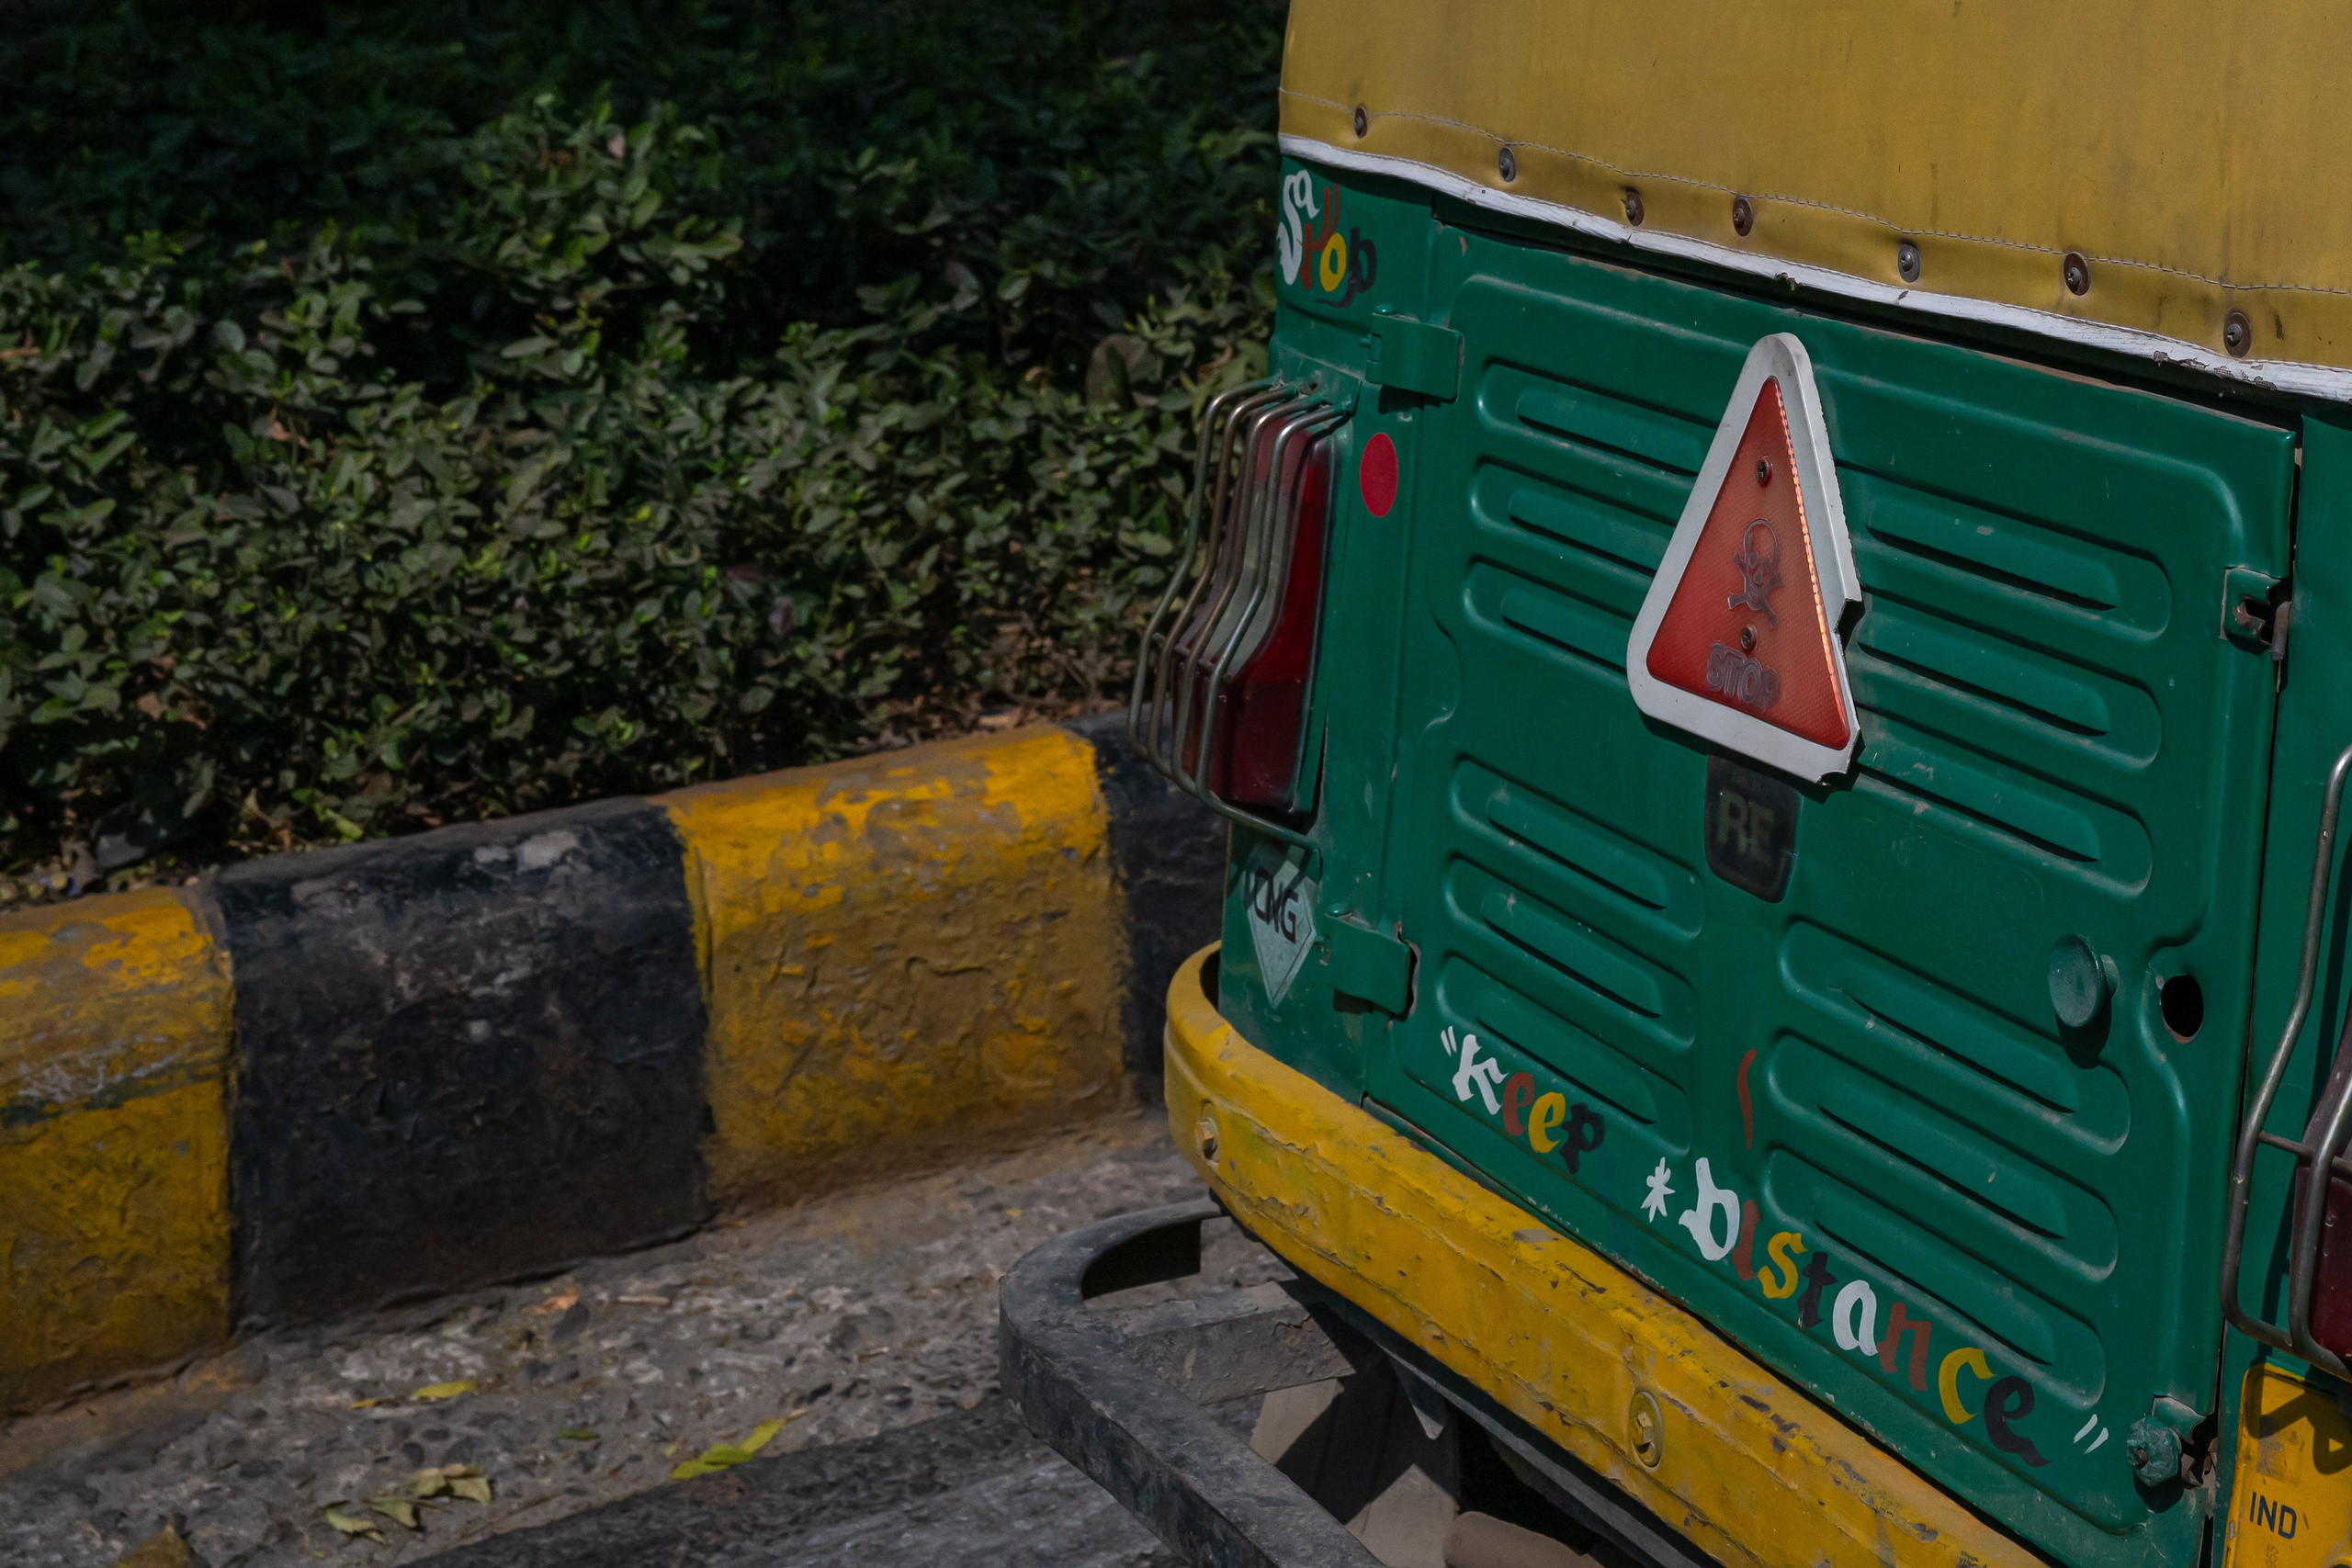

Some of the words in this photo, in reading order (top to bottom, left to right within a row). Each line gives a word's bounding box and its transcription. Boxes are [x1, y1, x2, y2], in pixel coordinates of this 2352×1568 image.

[1706, 641, 1780, 711] STOP
[1254, 866, 1300, 945] CNG
[2249, 1491, 2298, 1540] IND
